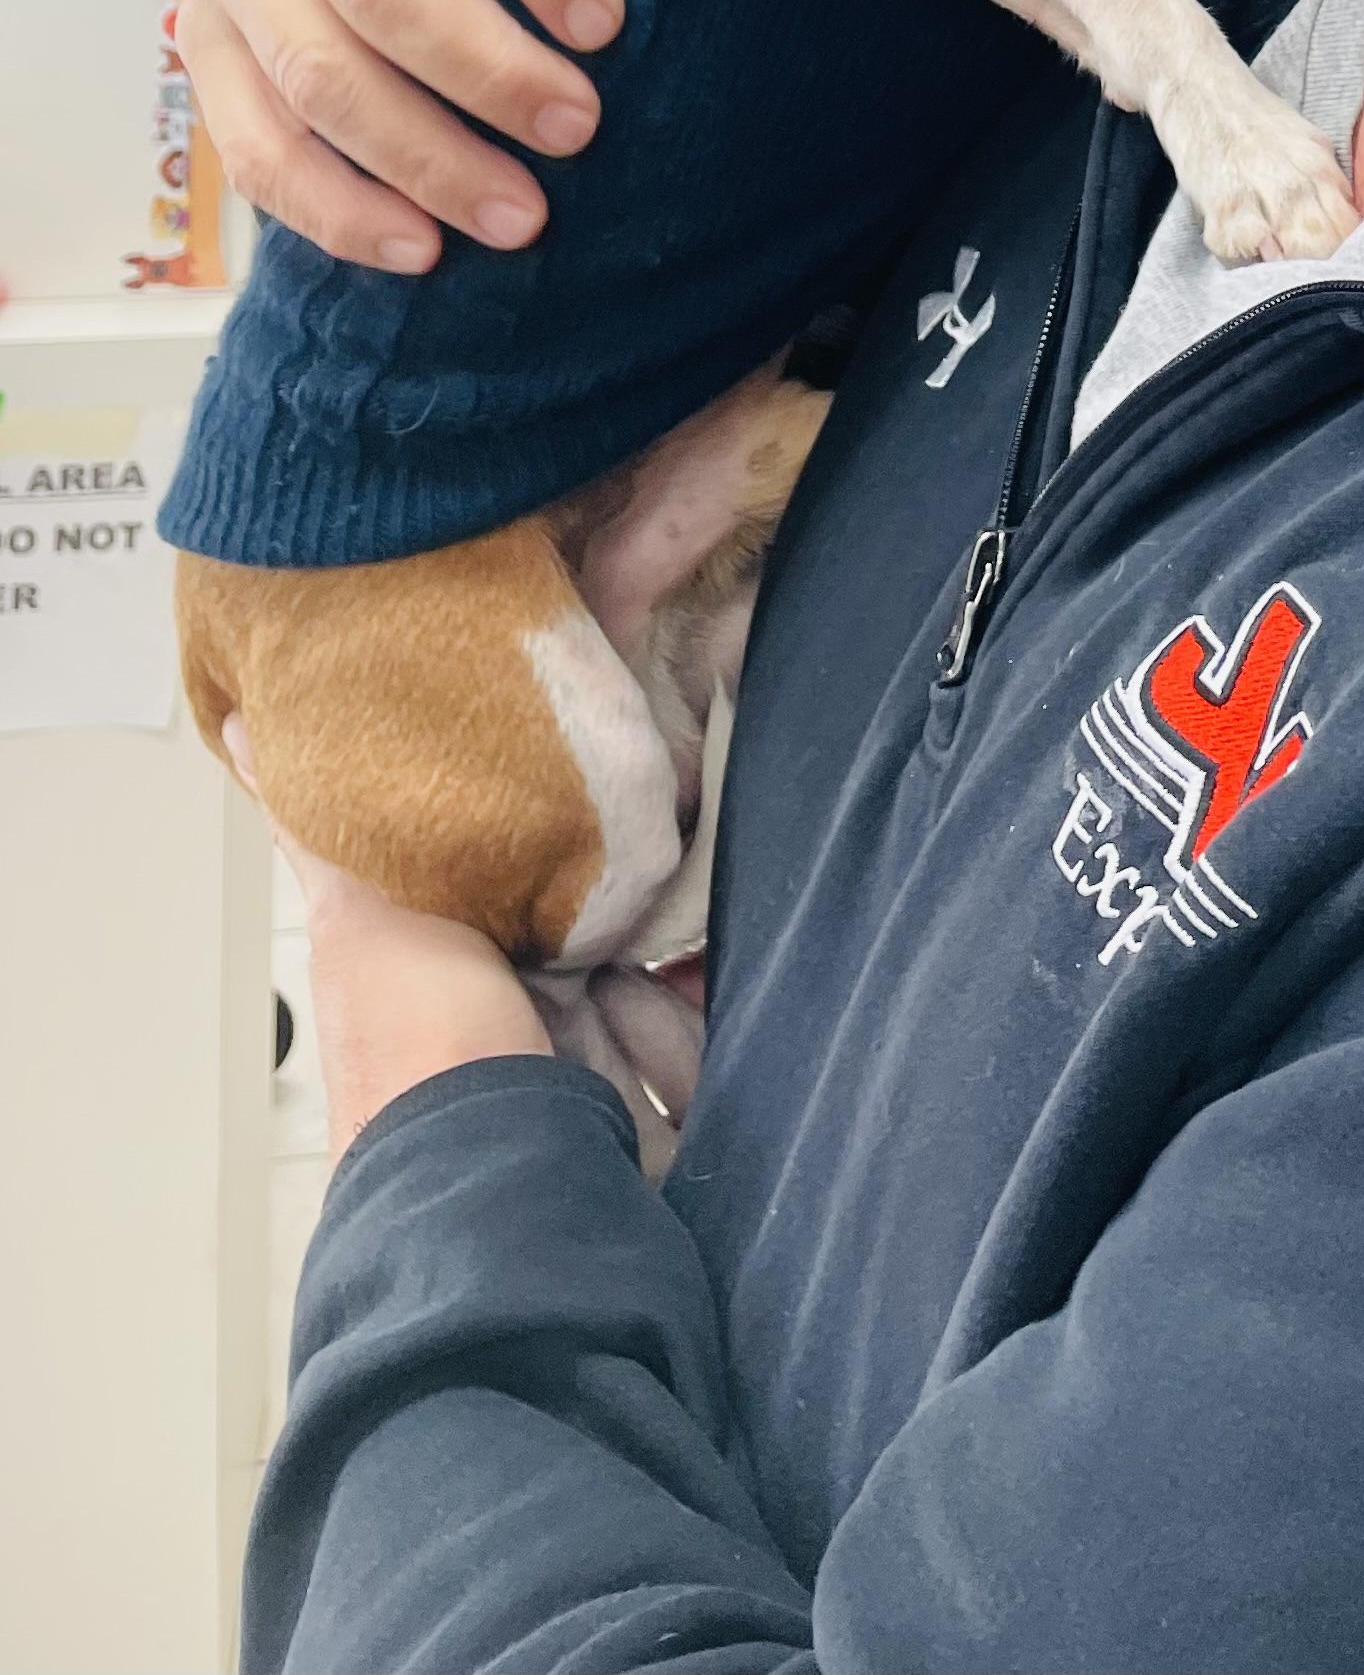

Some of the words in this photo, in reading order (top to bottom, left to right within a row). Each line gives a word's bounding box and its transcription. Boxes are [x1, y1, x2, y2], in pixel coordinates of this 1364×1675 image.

[27, 462, 146, 491] AREA
[0, 525, 36, 555] O
[55, 520, 144, 551] NOT
